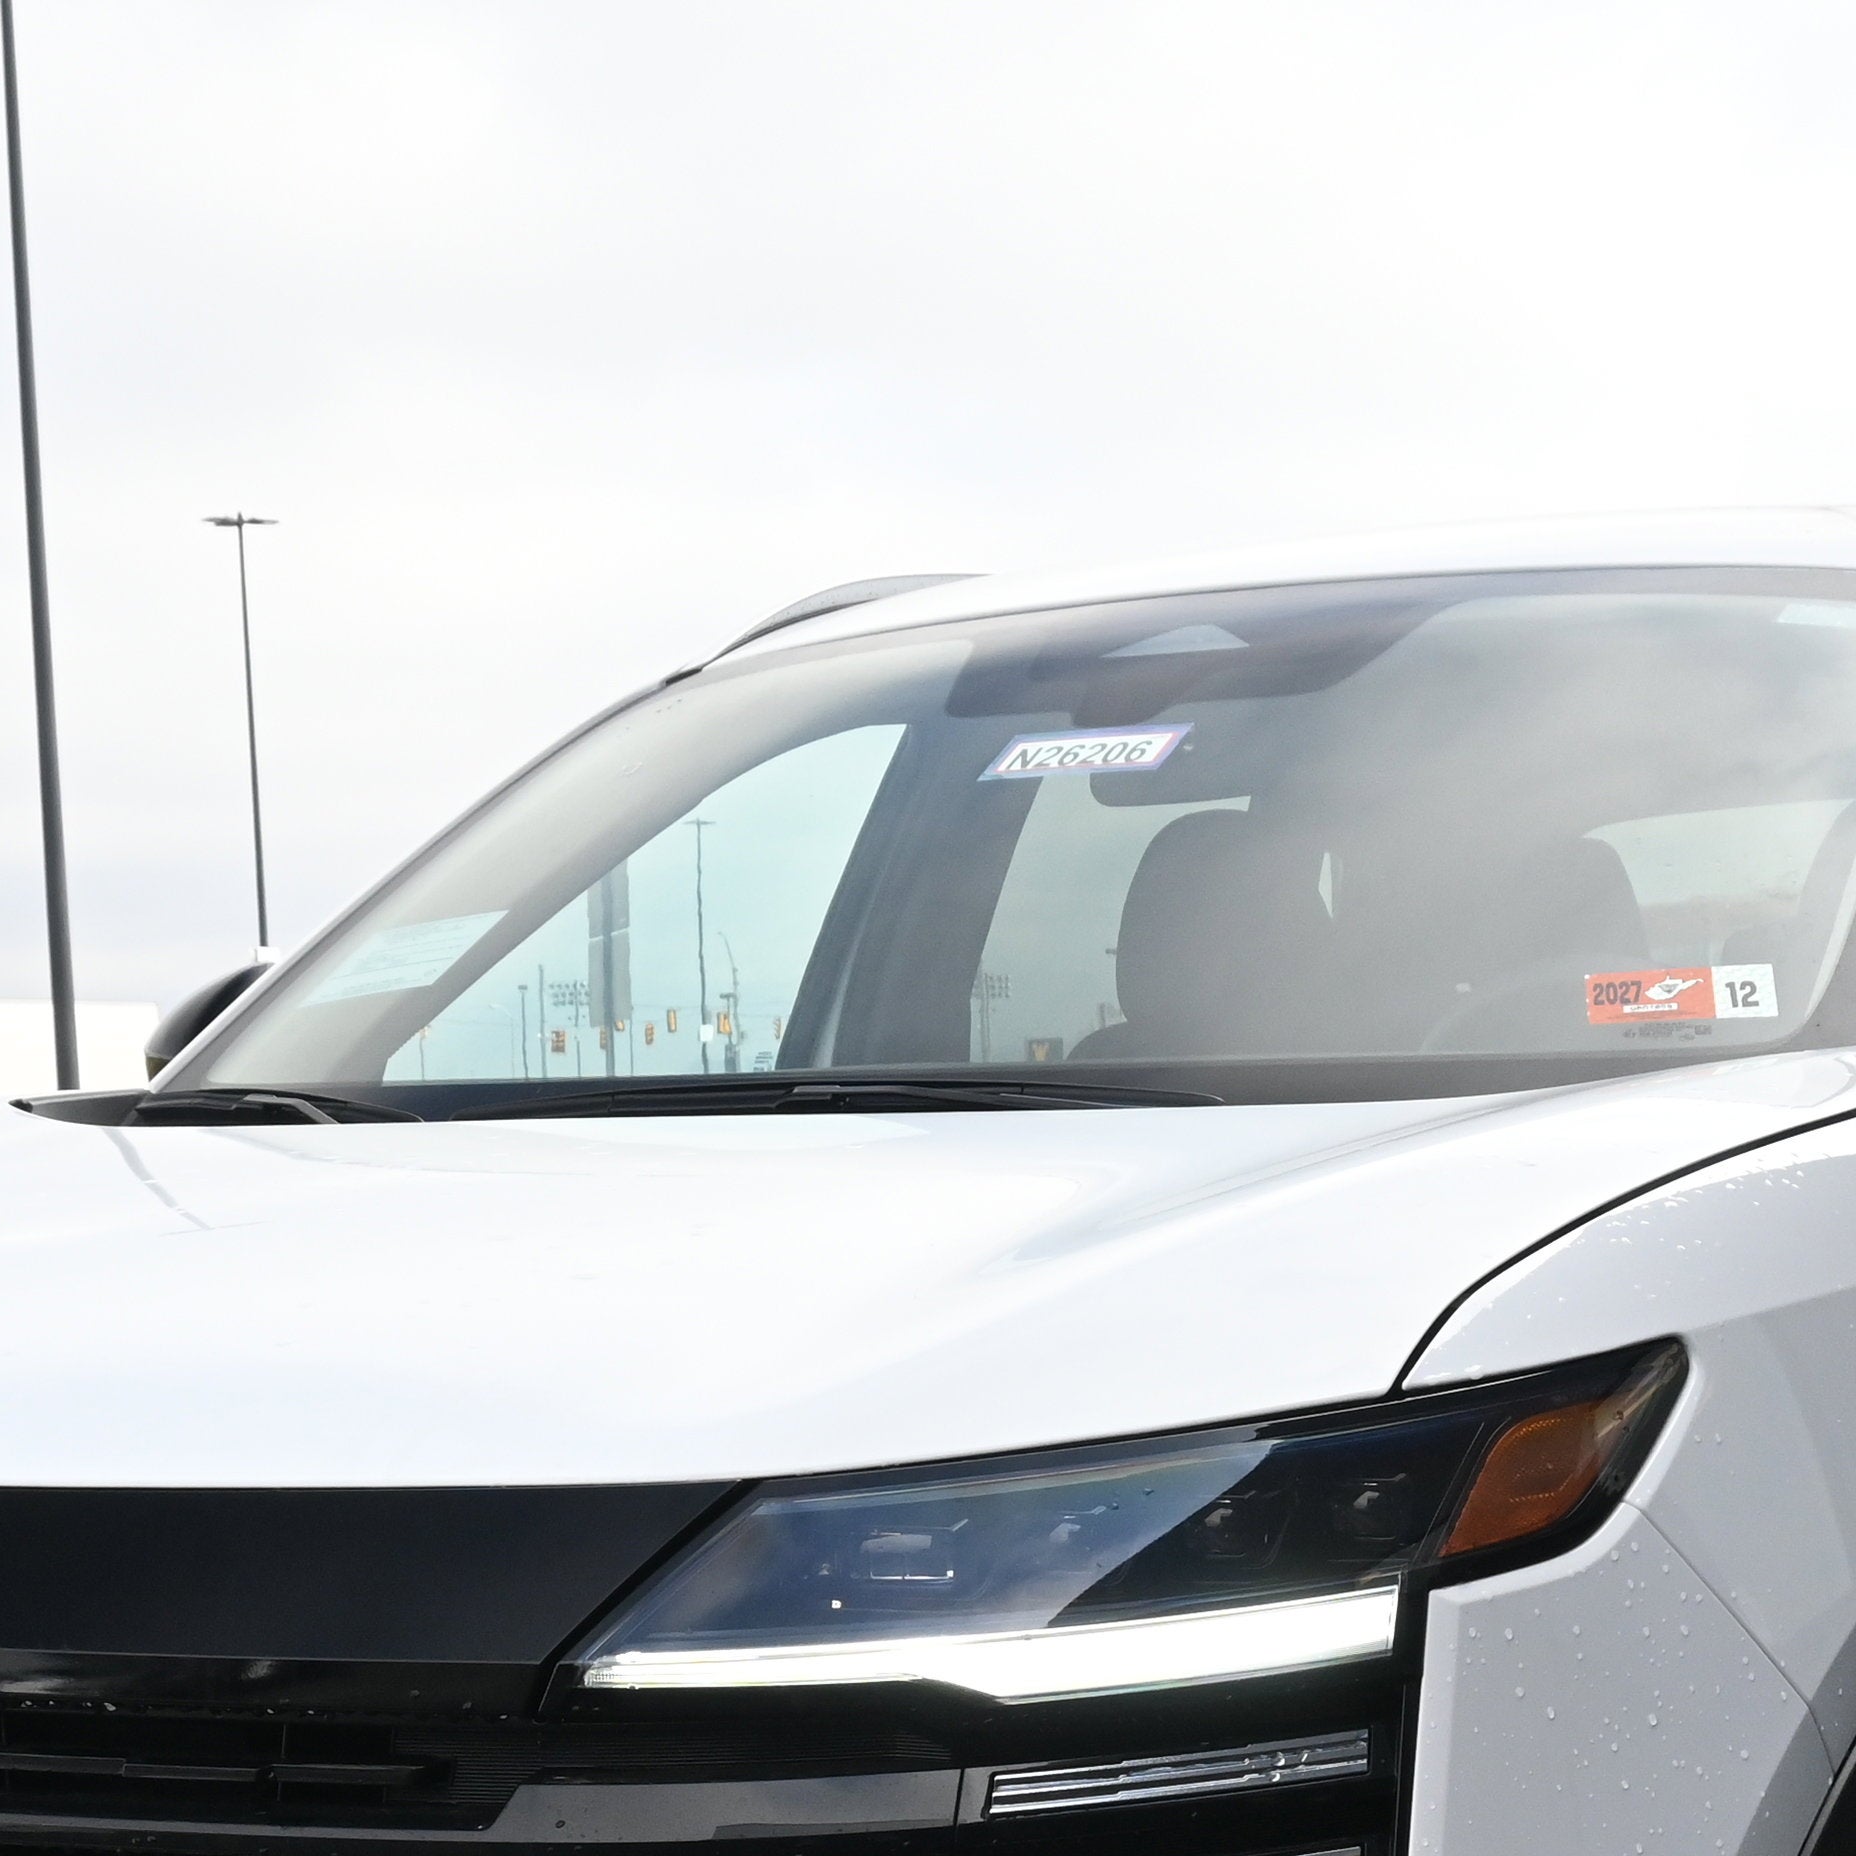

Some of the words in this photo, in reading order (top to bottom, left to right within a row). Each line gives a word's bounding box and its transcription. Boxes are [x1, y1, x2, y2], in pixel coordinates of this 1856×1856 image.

[1006, 740, 1153, 770] N26206
[1592, 980, 1642, 1006] 2027
[1725, 980, 1760, 1009] 12
